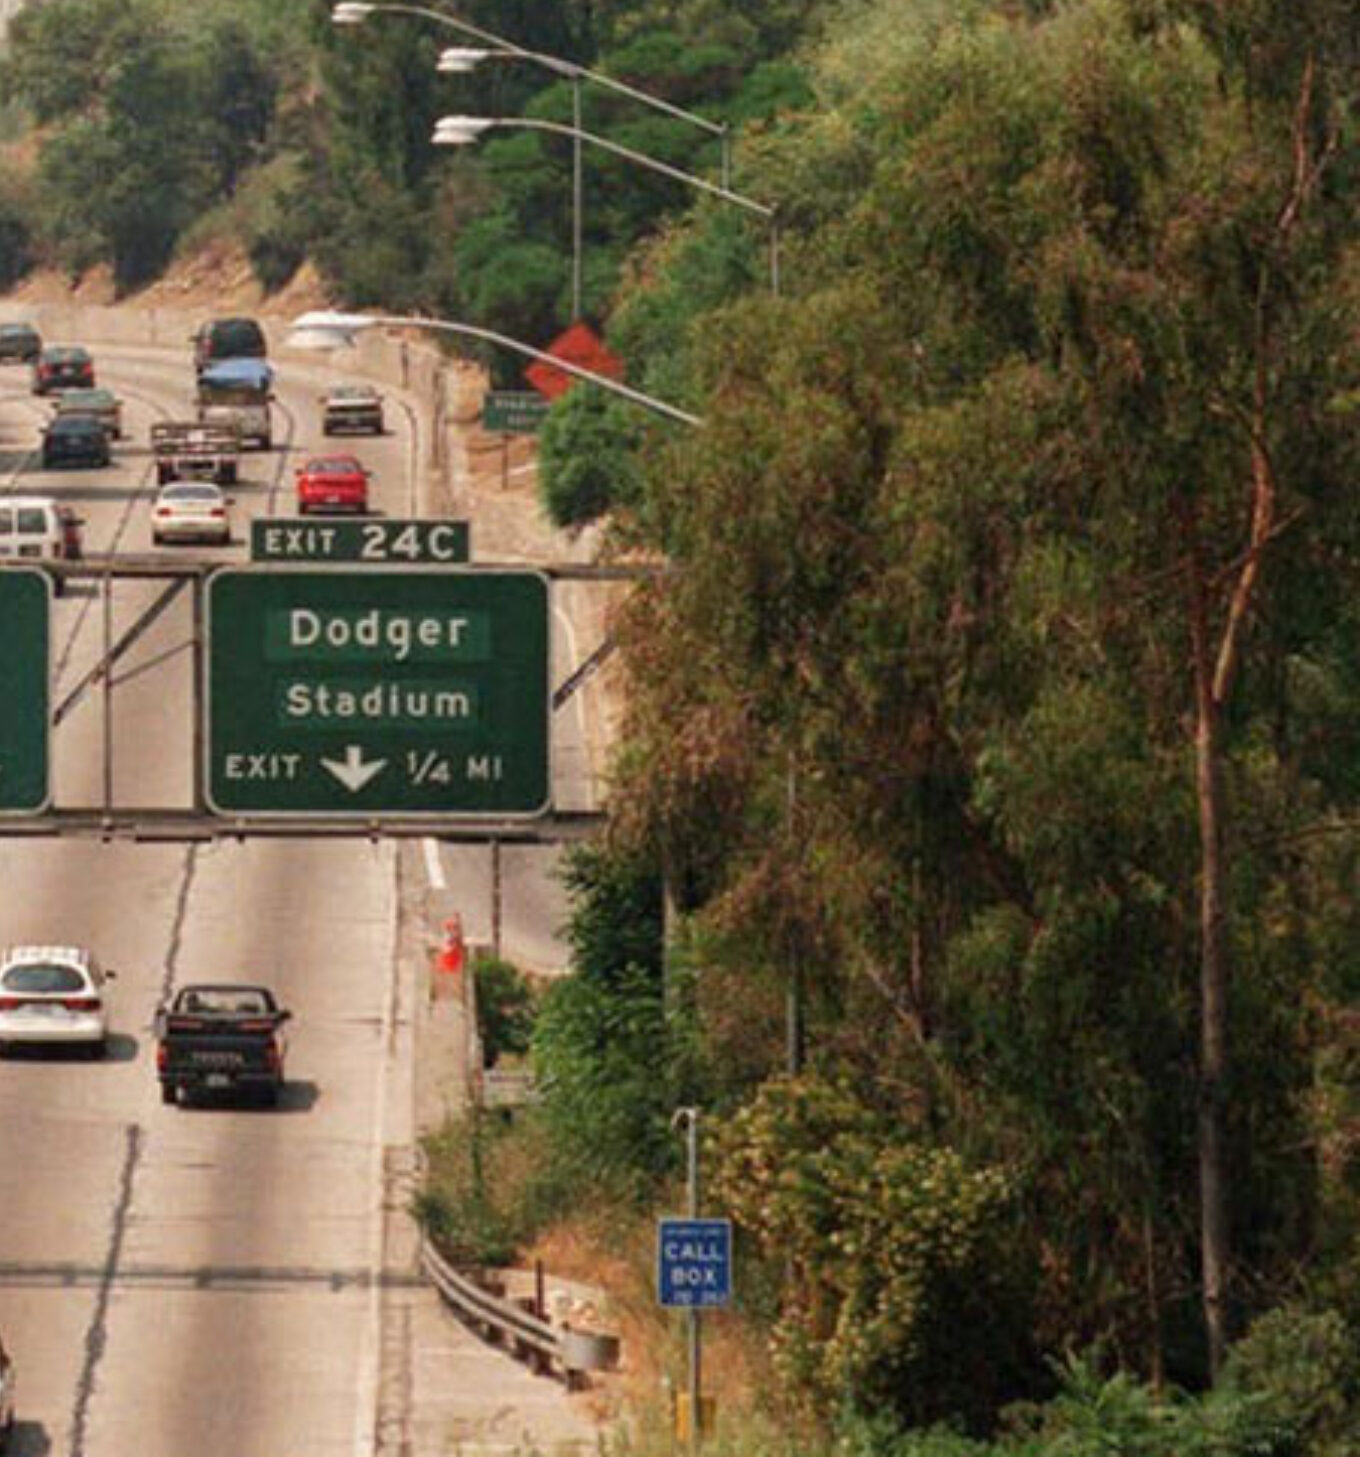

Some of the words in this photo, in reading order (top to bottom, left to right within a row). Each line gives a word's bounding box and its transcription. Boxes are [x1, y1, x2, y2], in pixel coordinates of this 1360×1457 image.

[264, 528, 336, 553] EXIT
[361, 526, 455, 559] 24C
[290, 609, 468, 661] Dodger
[286, 683, 470, 718] Stadium
[224, 754, 301, 780] EXIT
[466, 756, 503, 781] MI
[664, 1242, 723, 1262] CALL
[670, 1266, 717, 1287] BOX
